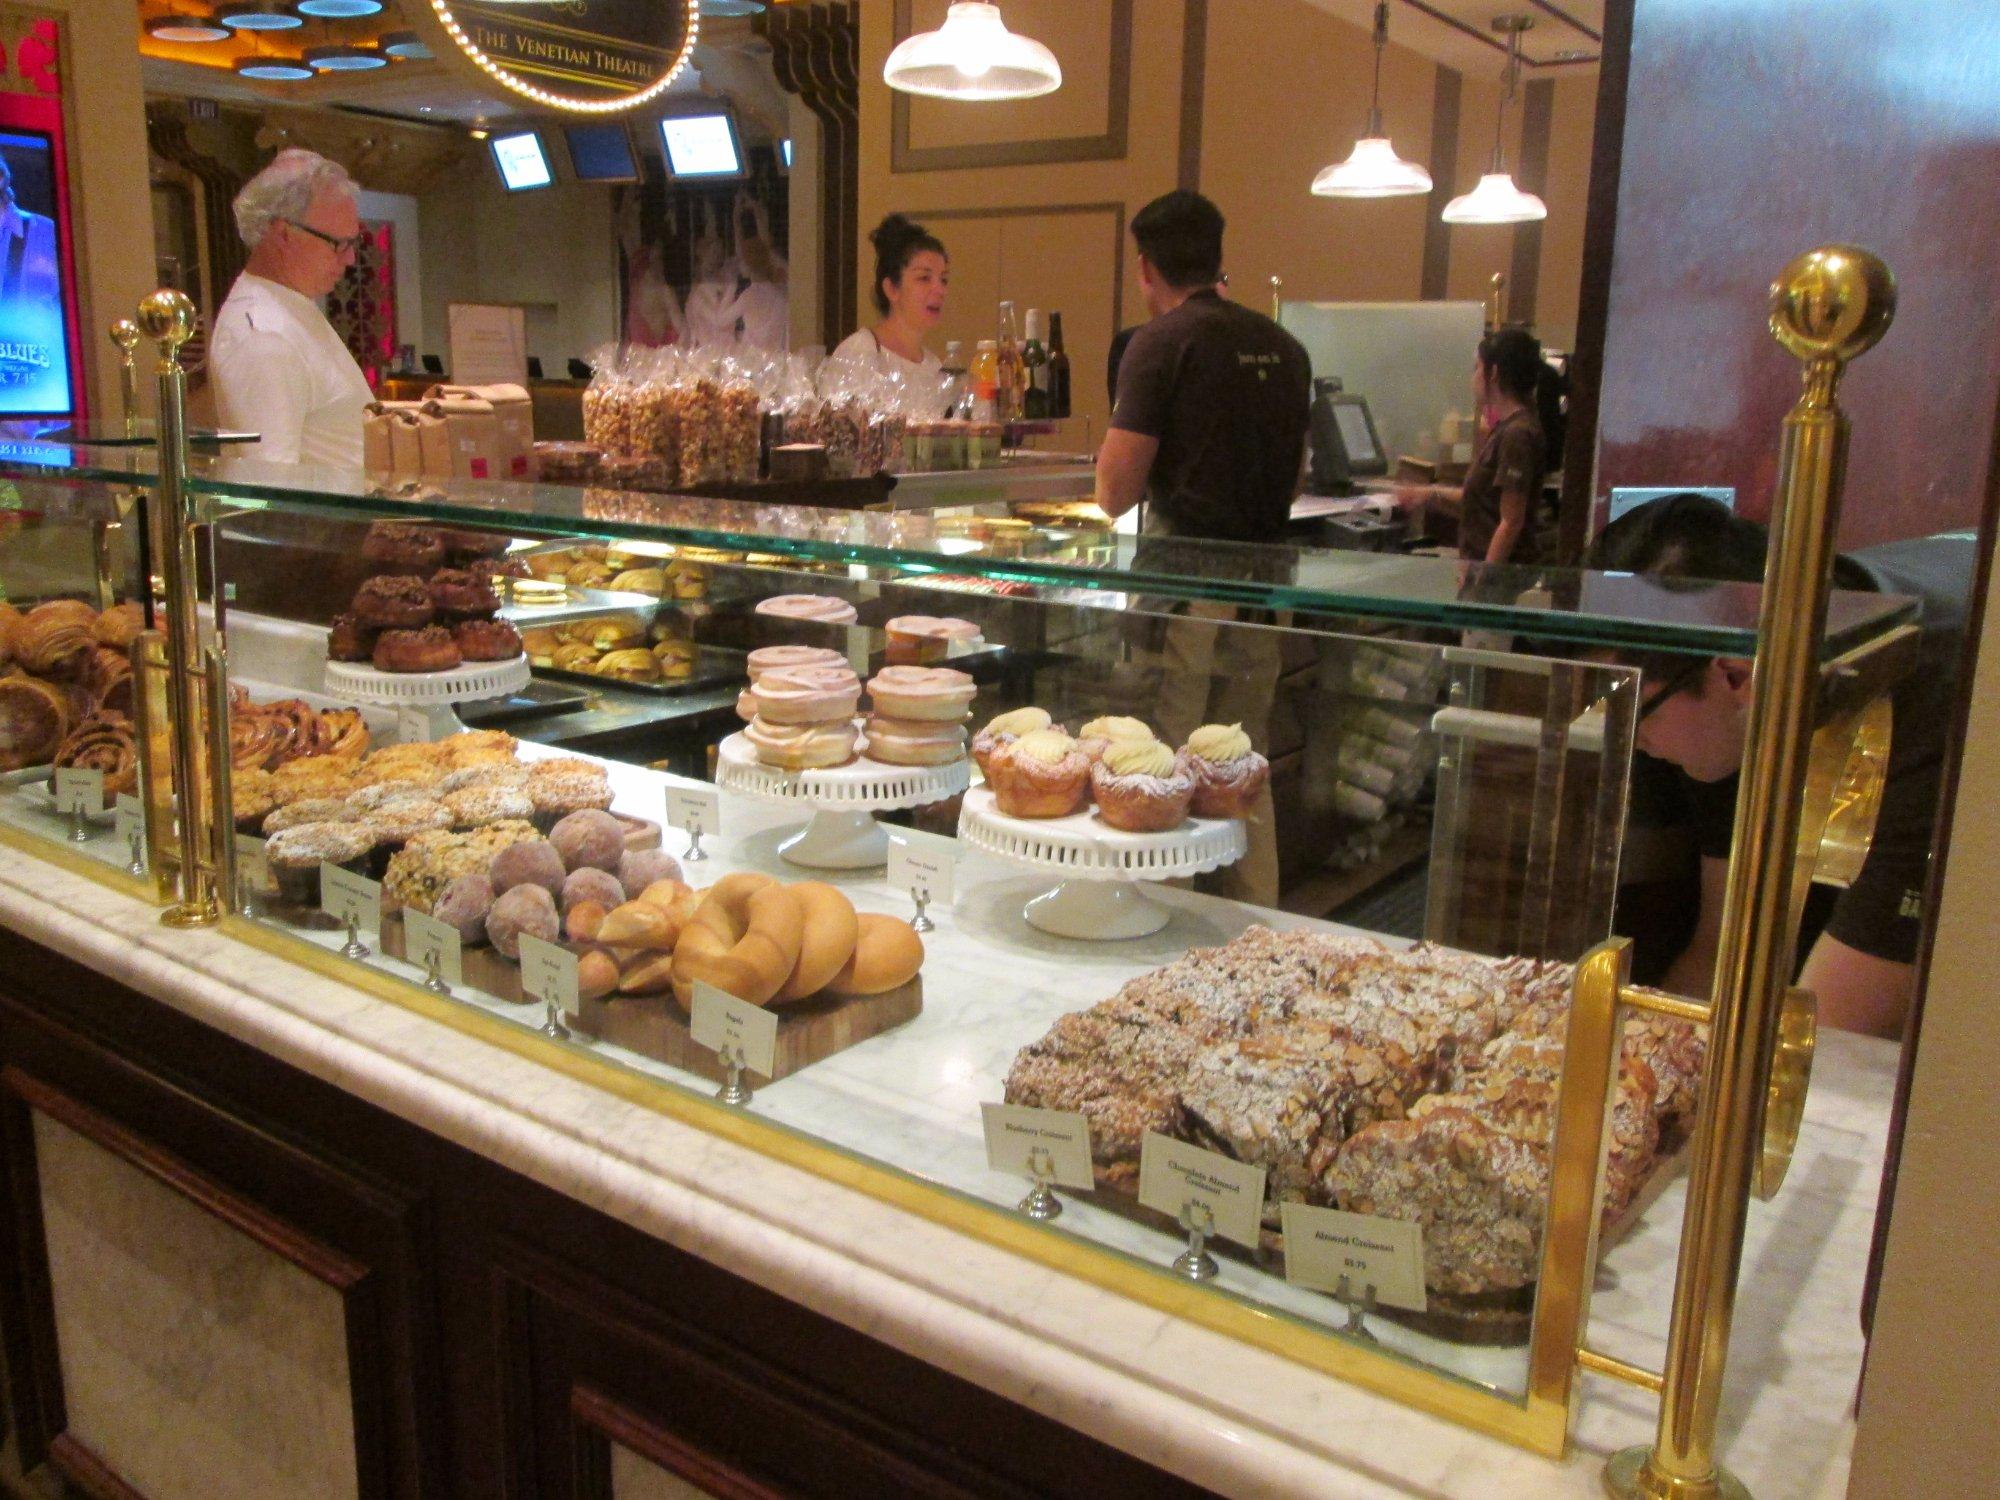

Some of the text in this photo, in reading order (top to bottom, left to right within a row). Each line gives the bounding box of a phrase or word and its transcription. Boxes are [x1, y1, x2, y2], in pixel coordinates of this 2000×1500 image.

[476, 28, 655, 78] THE VENETIAN THEATRE
[1167, 1159, 1241, 1195] Chocolate Almond
[1184, 1175, 1221, 1197] Croissant
[1315, 1229, 1395, 1252] Almond Croissant
